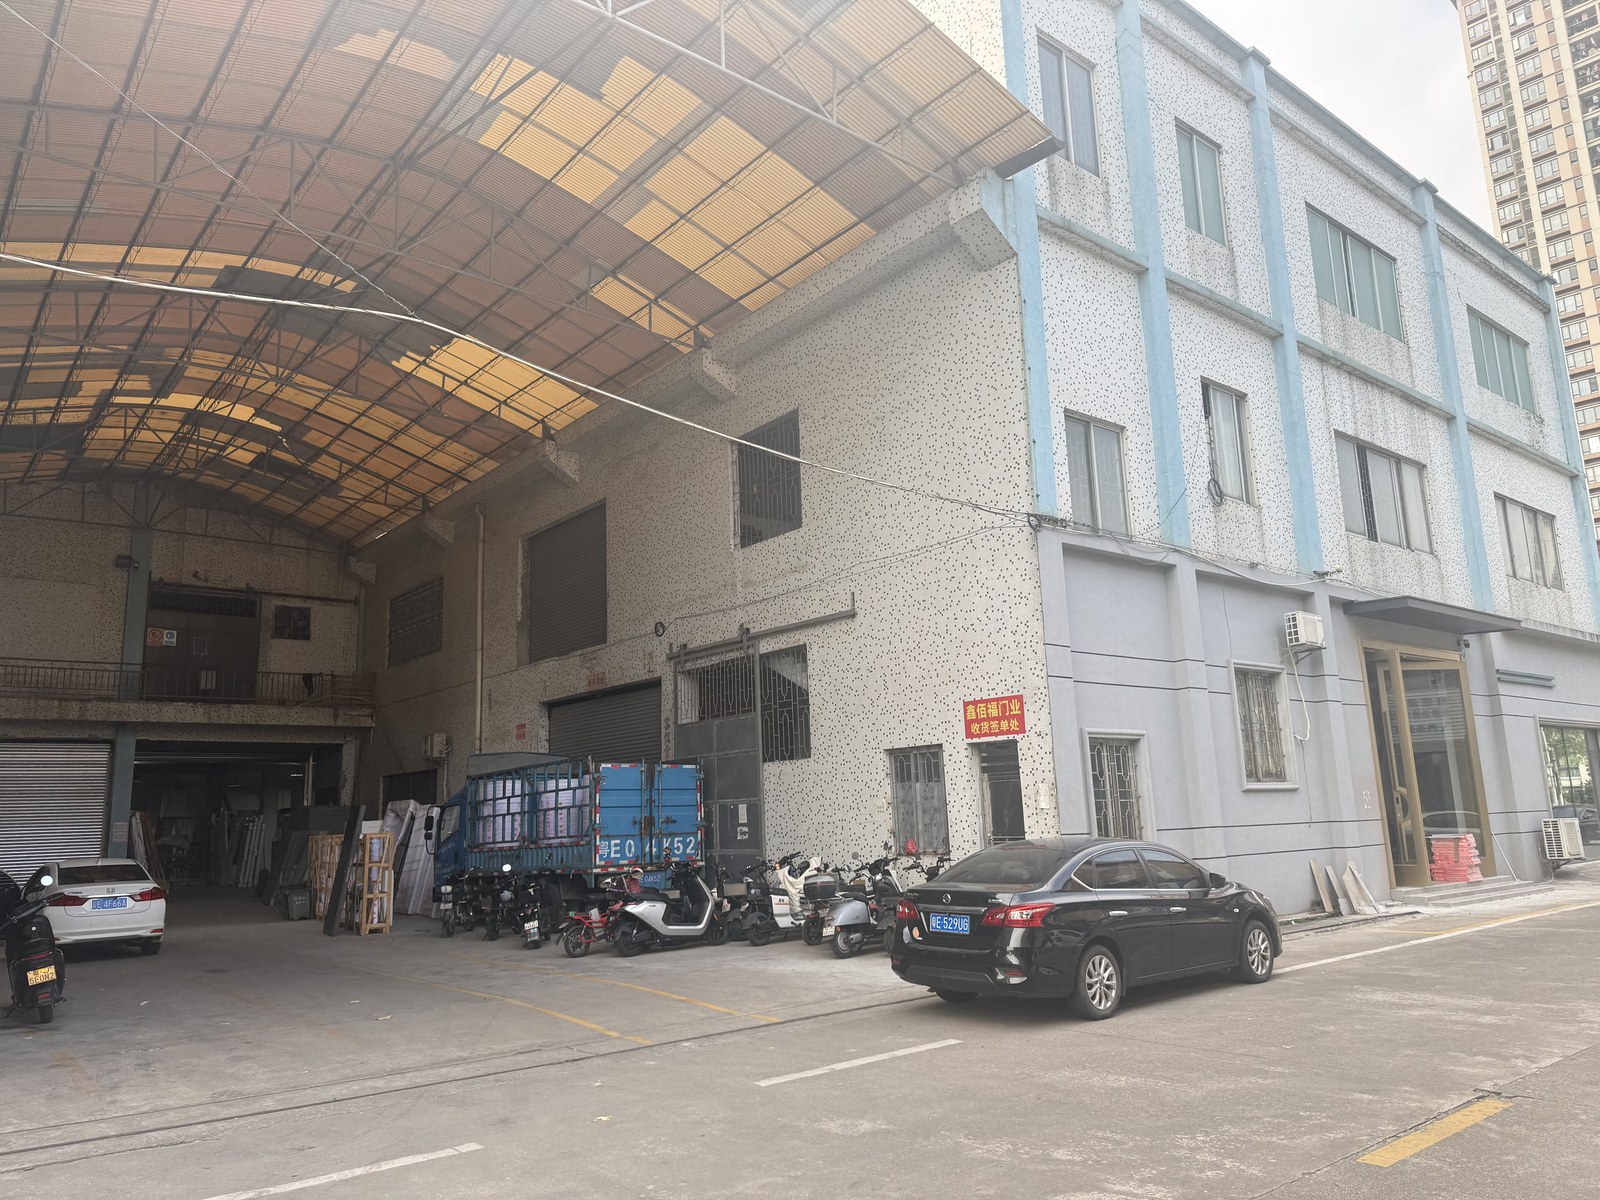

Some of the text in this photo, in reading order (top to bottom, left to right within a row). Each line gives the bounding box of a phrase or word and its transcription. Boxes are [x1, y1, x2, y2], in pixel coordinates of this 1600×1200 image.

[966, 699, 1021, 720] 鑫佰福门业
[971, 718, 1020, 735] 收货签单处
